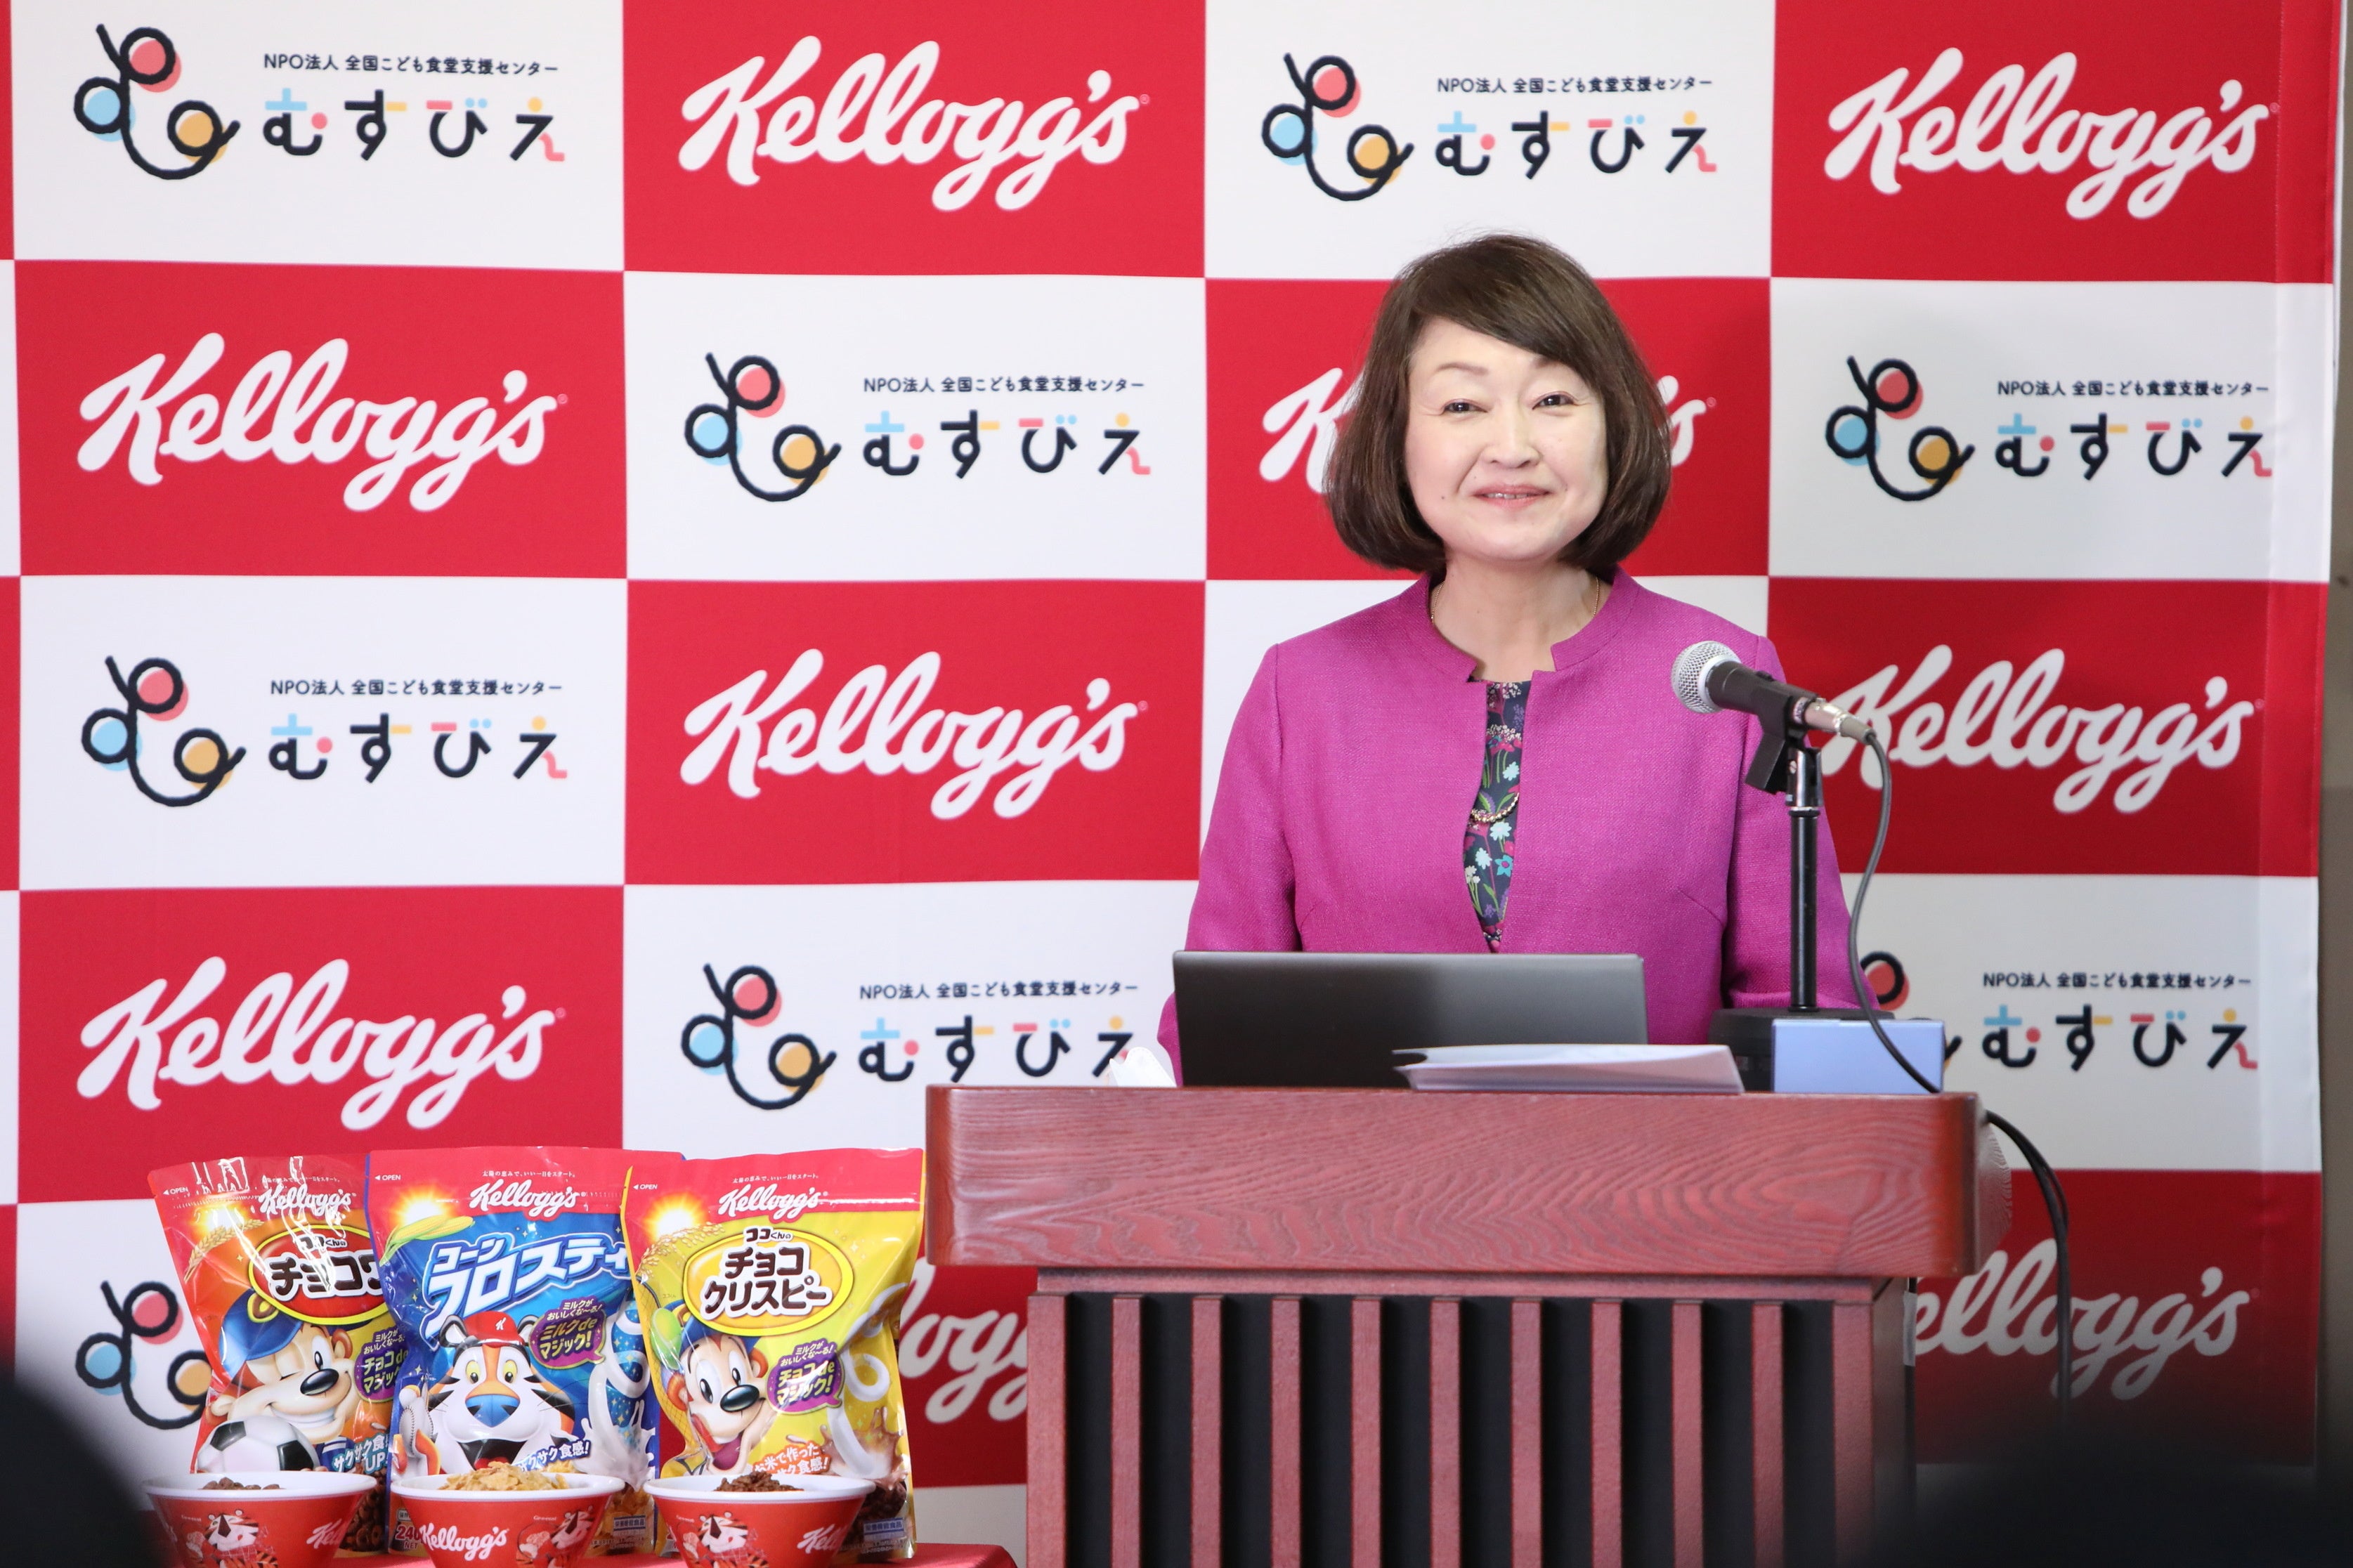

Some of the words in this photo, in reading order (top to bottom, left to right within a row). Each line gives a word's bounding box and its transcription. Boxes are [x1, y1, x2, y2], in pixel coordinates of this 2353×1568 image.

[263, 53, 339, 71] NPO法人
[345, 54, 558, 76] 全国こども食堂支援センター
[1438, 78, 1507, 93] NPO法人
[1513, 76, 1712, 94] 全国こども食堂支援センター
[263, 88, 565, 162] むすびえ
[679, 35, 1140, 211] Kellogg's
[1824, 47, 2269, 219] Kellogg's
[1435, 110, 1716, 180] むすびえ
[863, 377, 934, 393] NPO法人
[941, 376, 1144, 393] 全国こども食堂支援センター
[1997, 381, 2066, 396] NPO法人
[2073, 380, 2271, 397] 全国こども食堂支援センター
[77, 332, 558, 512] Kellogg's
[863, 410, 1151, 479] むすびえ
[1995, 412, 2272, 481] むすびえ
[271, 680, 345, 695] NPO法人
[351, 679, 563, 695] 全国こども食堂支援センター
[268, 712, 568, 783] むすびえ
[680, 648, 1138, 820] Kellogg's
[1822, 644, 2255, 814] Kellogg's
[860, 984, 930, 1000] NPO法人
[937, 981, 1139, 998] 全国こども食堂支援センター
[1983, 973, 2050, 988] NPO法人
[2057, 972, 2252, 989] 全国こども食堂支援センター
[77, 956, 555, 1130] Kellogg's
[1981, 1004, 2257, 1072] むすびえ
[169, 1187, 189, 1195] OPEN
[258, 1182, 351, 1220] Kellogg's
[468, 1178, 580, 1218] Kellogg's
[717, 1183, 821, 1220] Kellogg's
[745, 1227, 791, 1243] ココくんの
[432, 1238, 506, 1274] コーン
[724, 1246, 804, 1279] チョコ
[563, 1298, 594, 1310] ミルクが
[704, 1275, 827, 1314] クリスピー
[374, 1328, 399, 1342] ミルクが
[1916, 1239, 2250, 1400] ellogg's
[539, 1331, 592, 1359] マジック!
[795, 1340, 825, 1355] ミルクが
[334, 1434, 389, 1472] サクサク食
[419, 1522, 509, 1562] Kellogg's
